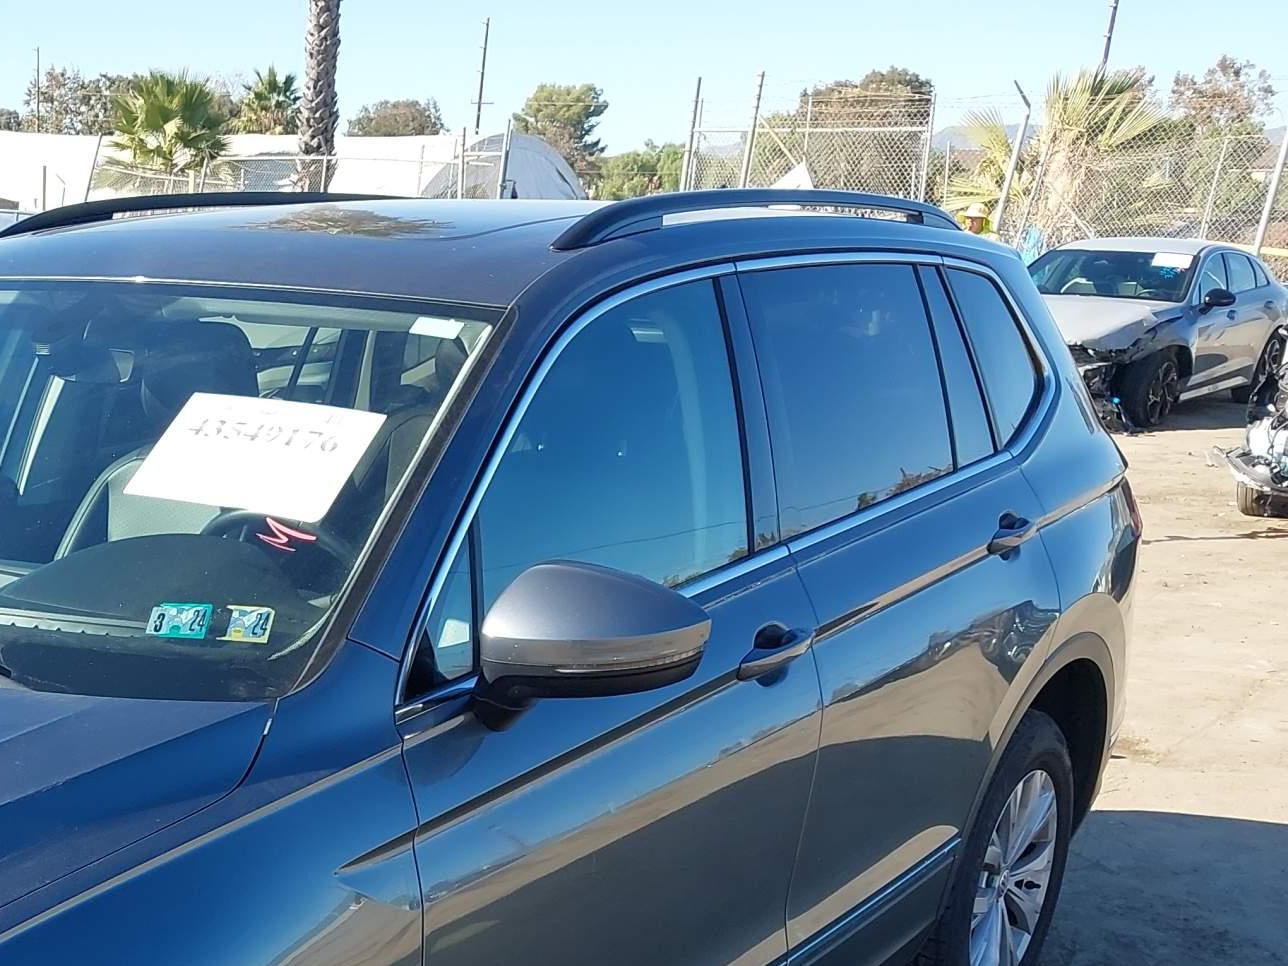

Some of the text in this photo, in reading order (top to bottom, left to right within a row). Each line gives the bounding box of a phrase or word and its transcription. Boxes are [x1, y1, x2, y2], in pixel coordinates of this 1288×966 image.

[153, 608, 208, 633] 3 24
[251, 612, 271, 636] 24
